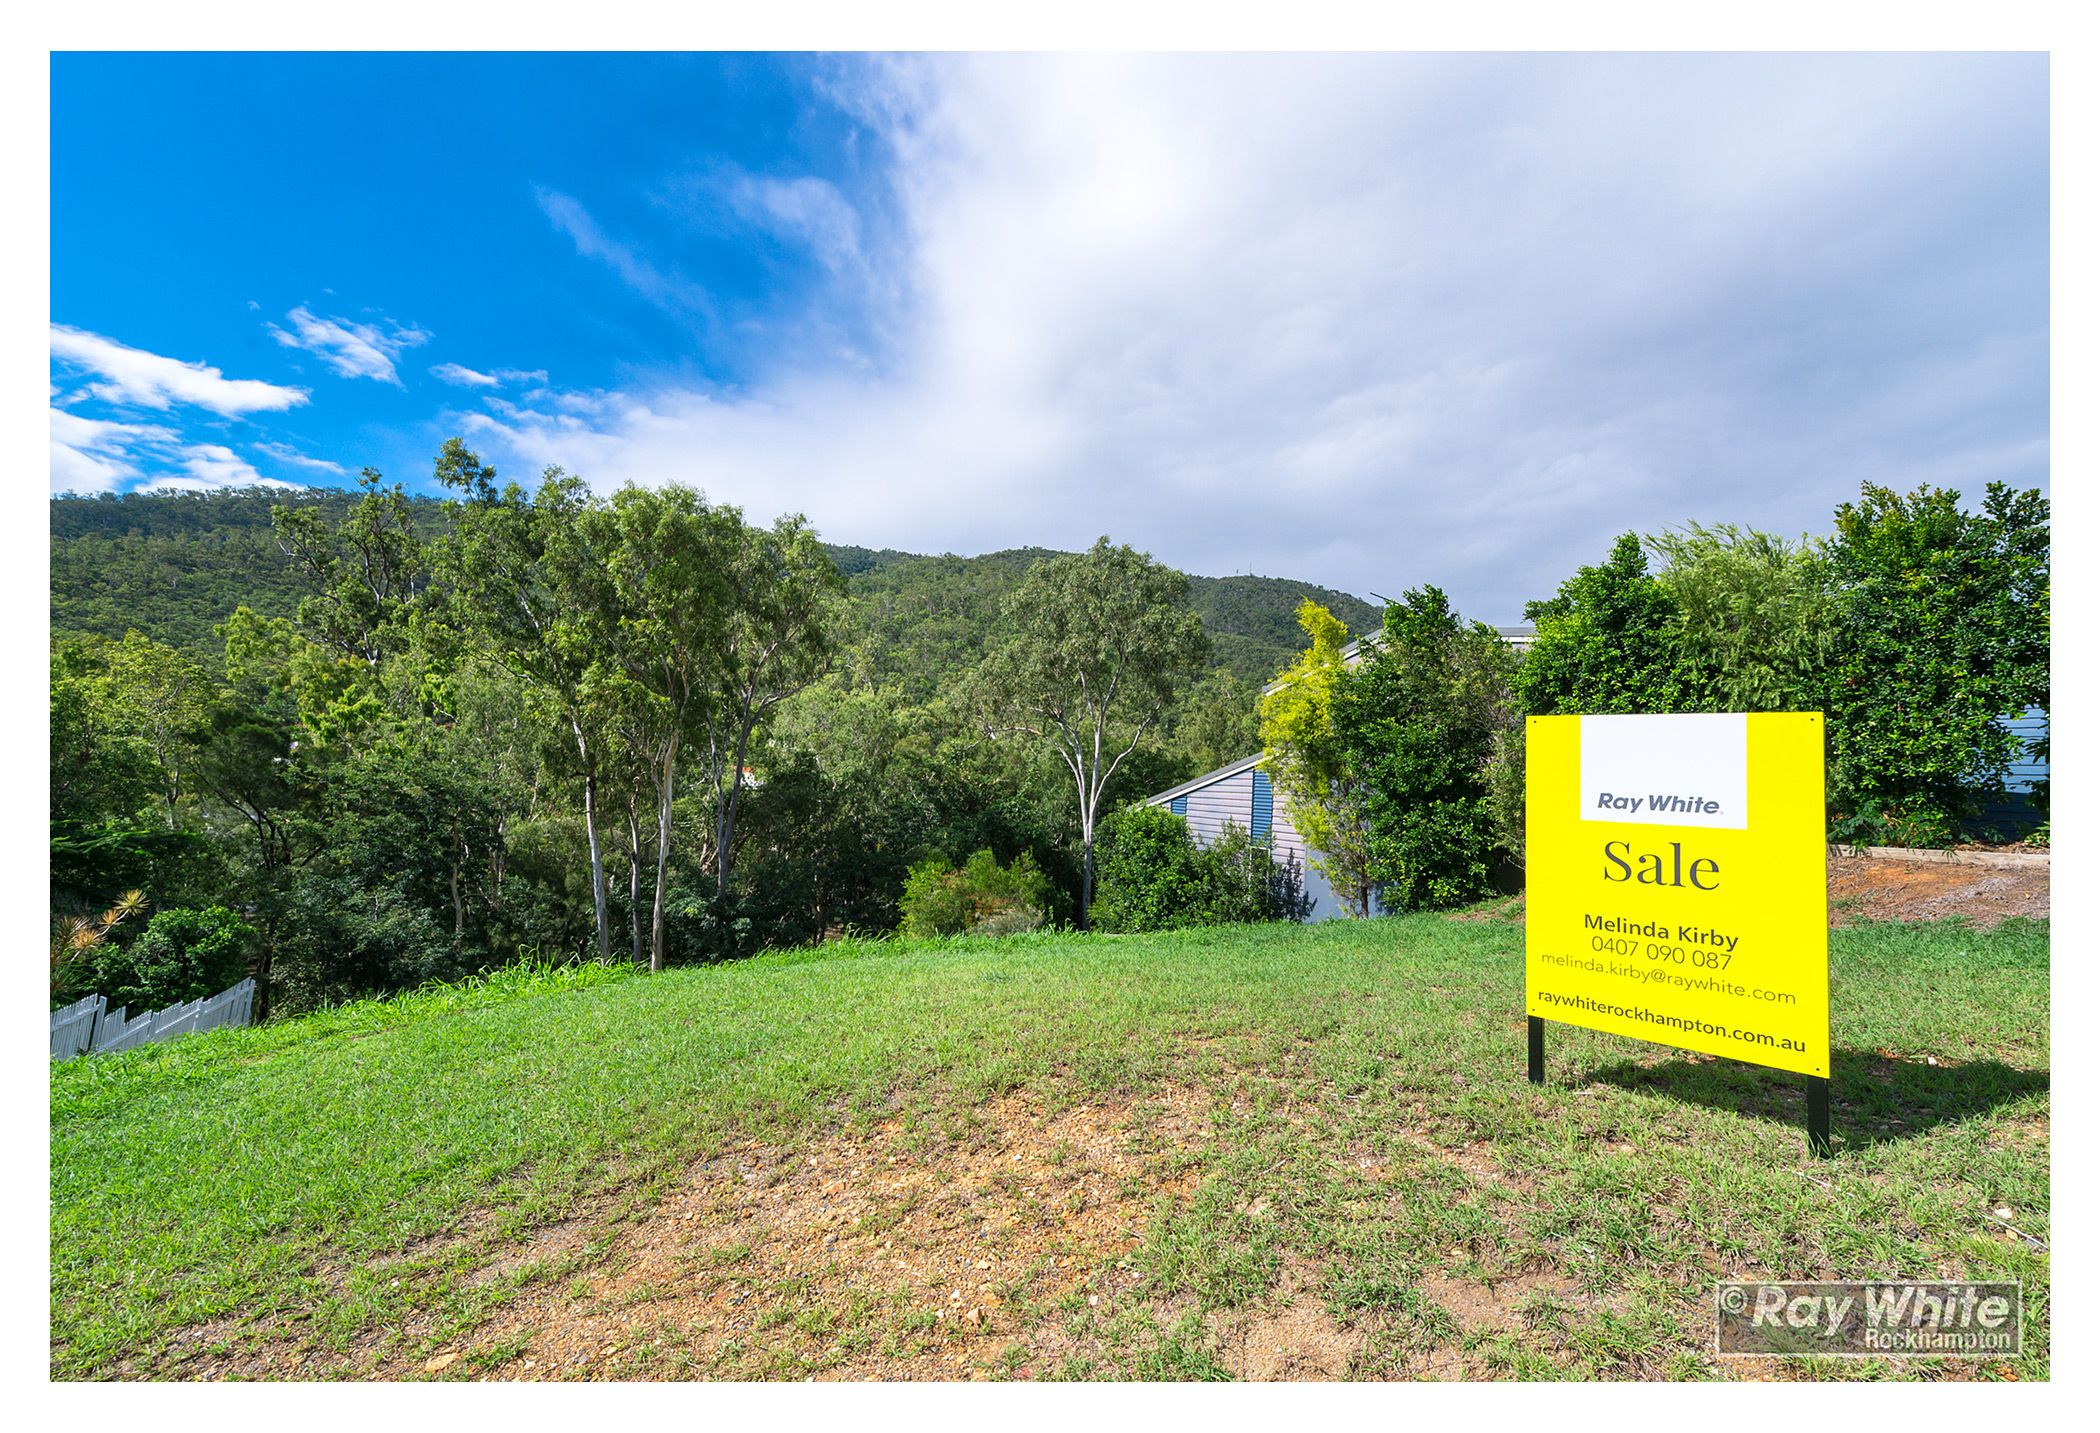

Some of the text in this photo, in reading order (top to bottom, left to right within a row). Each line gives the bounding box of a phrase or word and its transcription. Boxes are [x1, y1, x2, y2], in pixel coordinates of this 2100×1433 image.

[1597, 792, 1720, 815] Ray White
[1603, 840, 1720, 891] Sale
[1584, 913, 1739, 952] Melinda Kirby
[1591, 936, 1732, 971] 0407 090 087
[1541, 952, 1796, 1005] melinda.kirby@raywhite.com
[1538, 990, 1806, 1053] raywhiterockhampton.com.au
